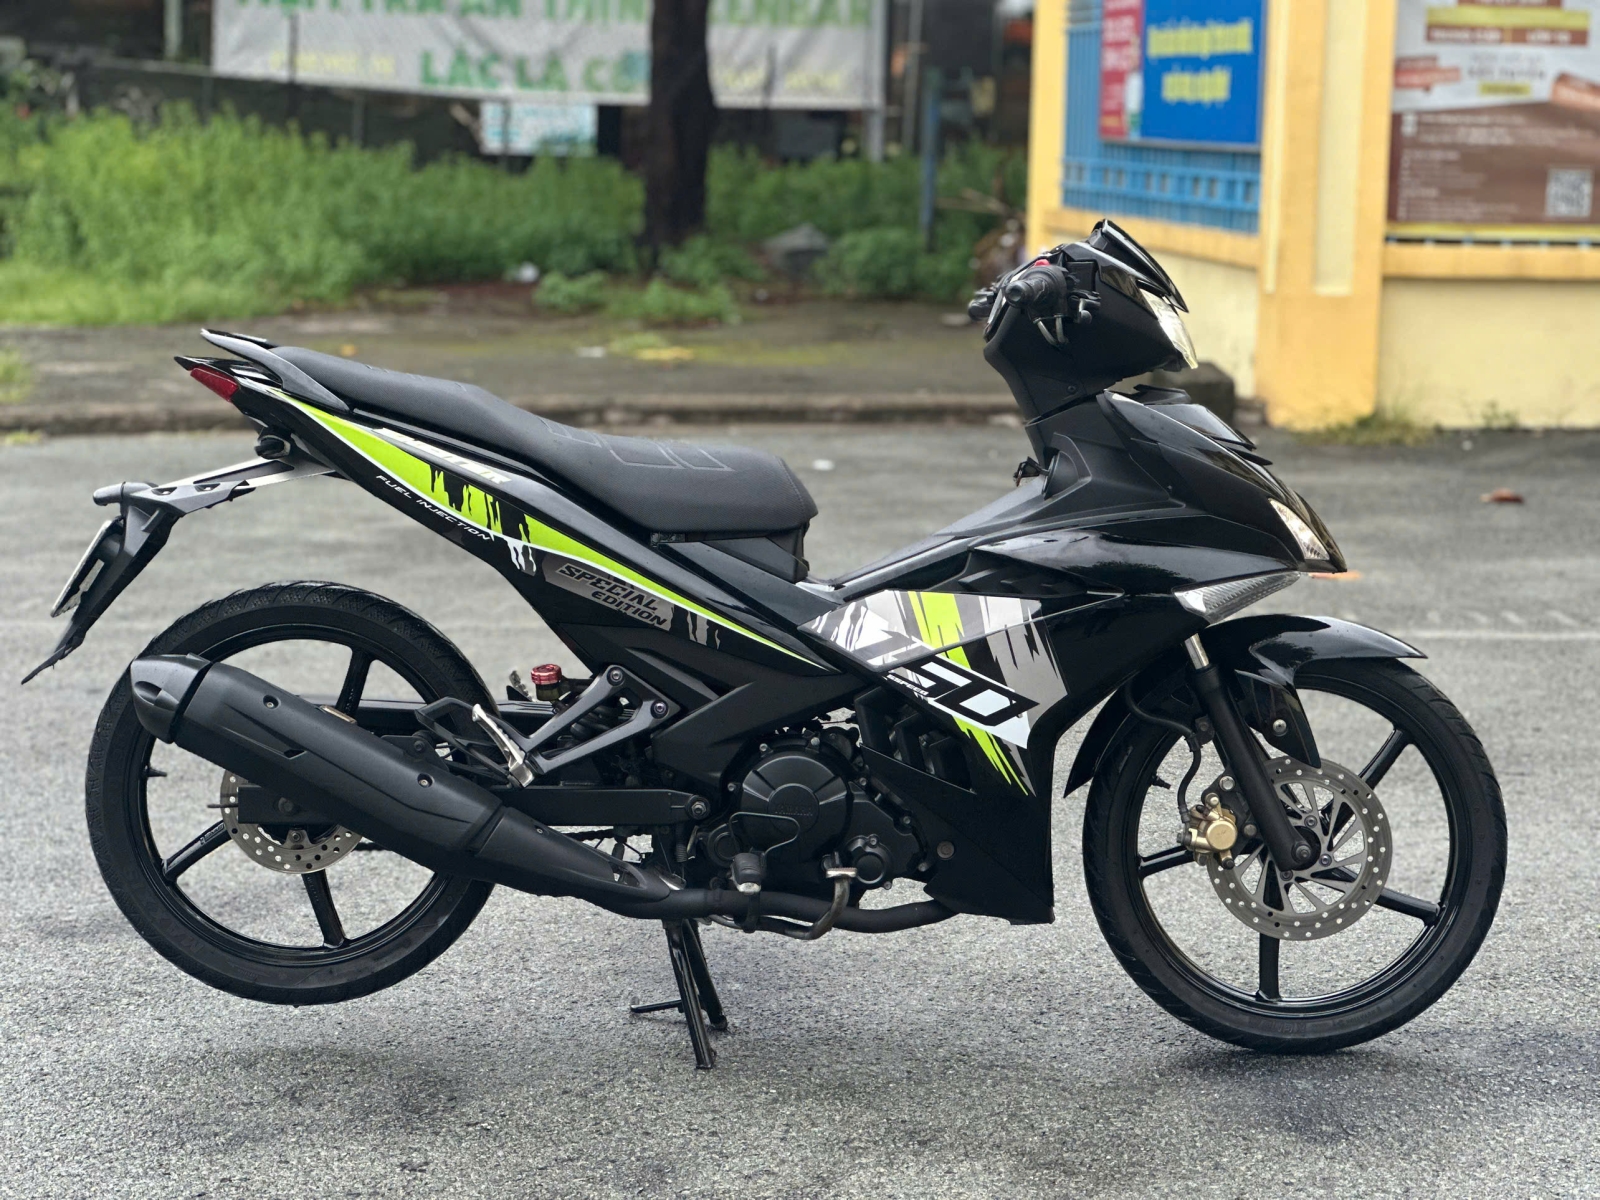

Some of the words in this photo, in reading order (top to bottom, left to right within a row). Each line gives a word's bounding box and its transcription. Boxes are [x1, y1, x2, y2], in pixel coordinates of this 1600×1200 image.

[375, 475, 412, 499] FUEL
[416, 499, 491, 541] INJECTION
[557, 563, 659, 611] SPECIAL
[591, 590, 668, 626] EDITION
